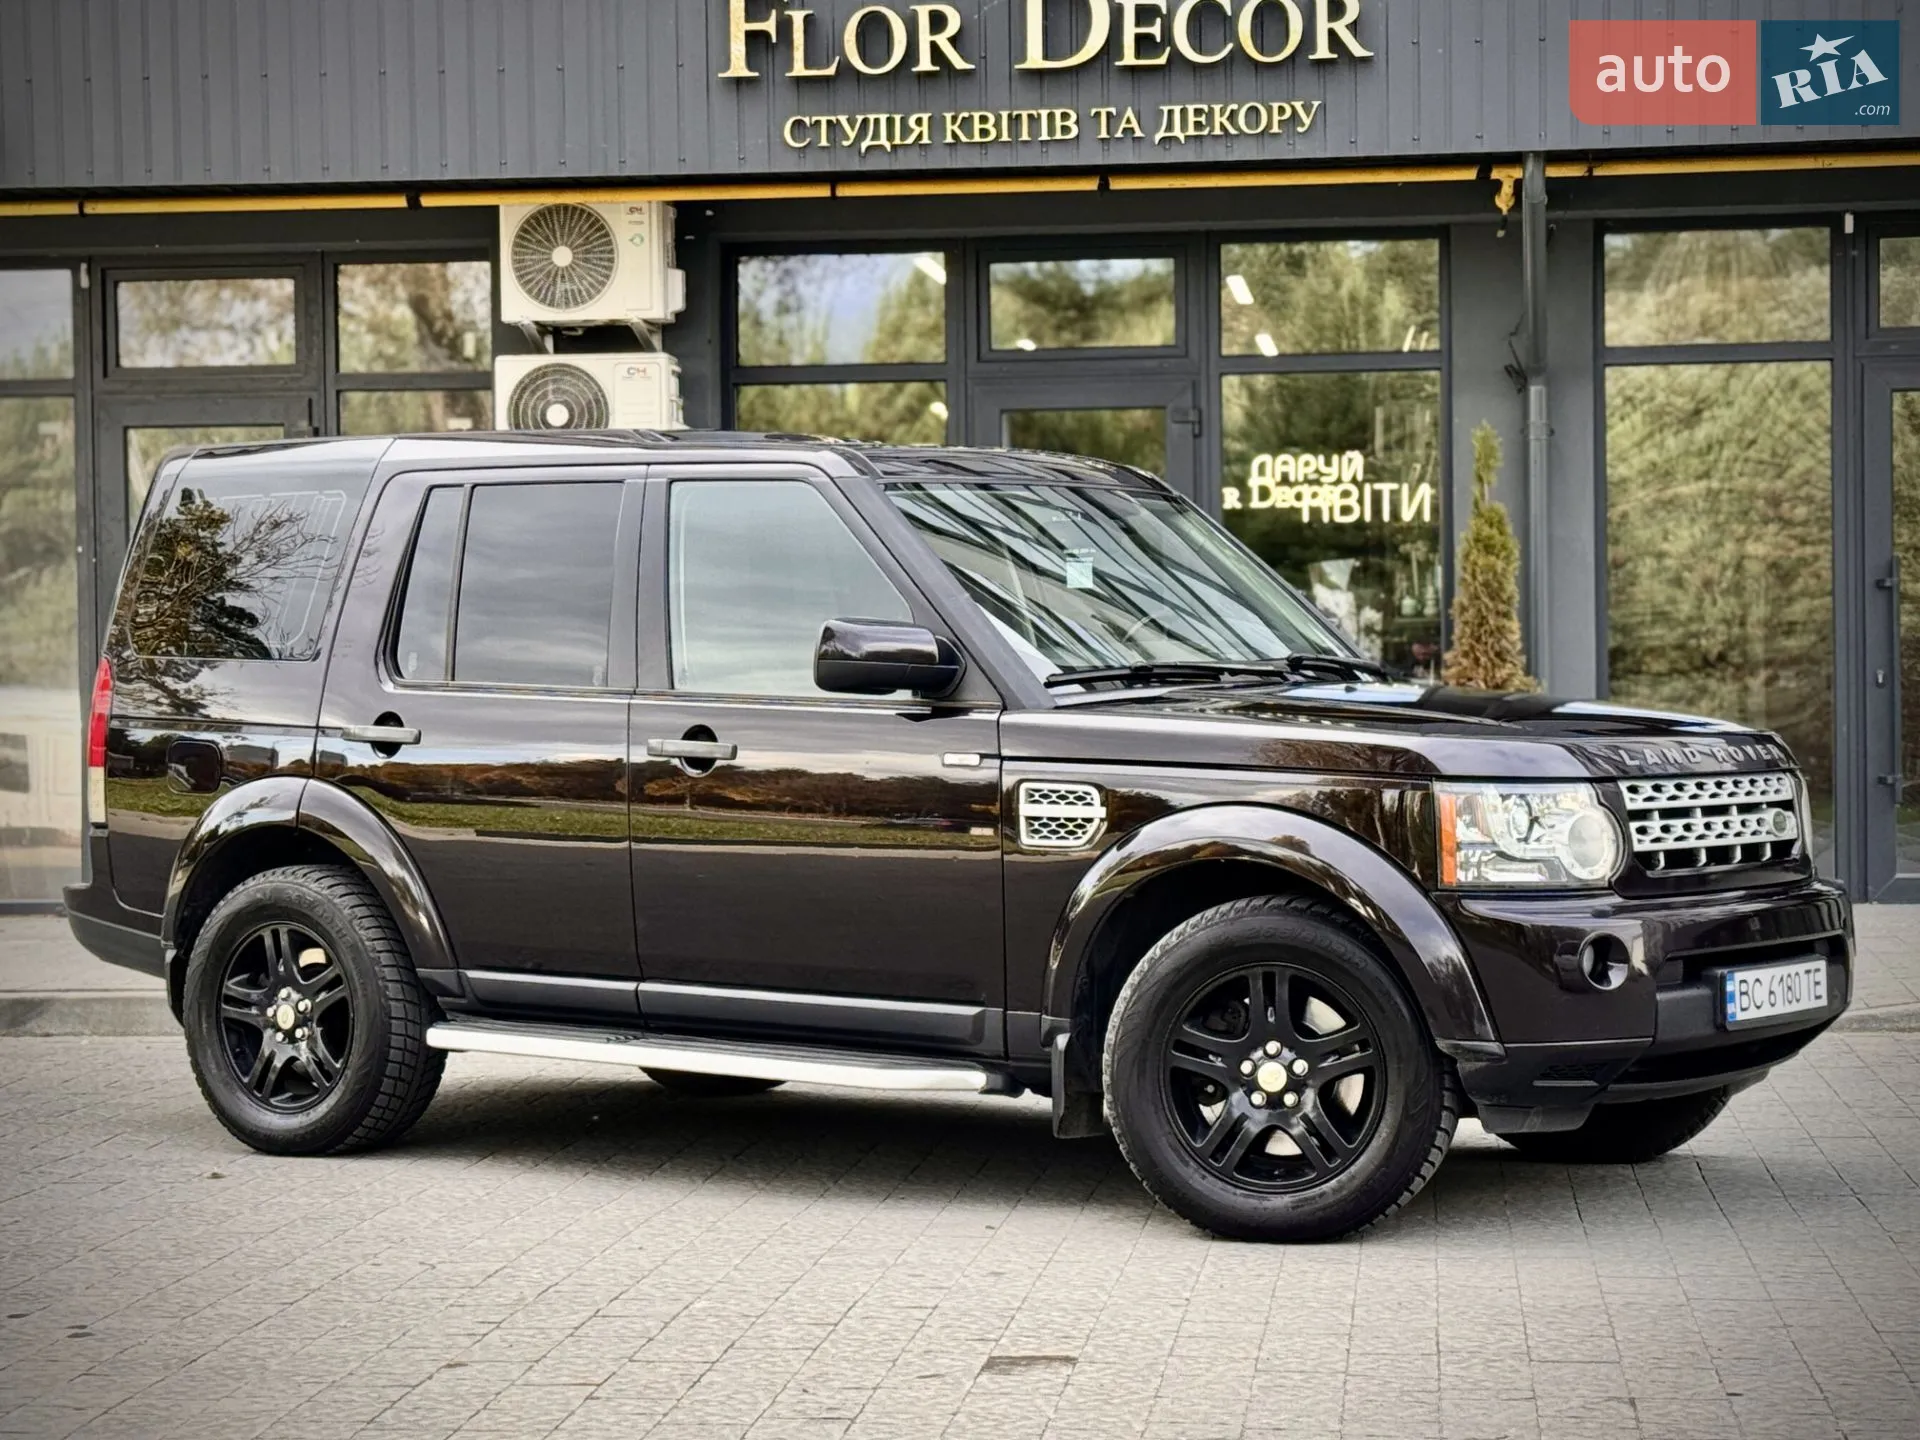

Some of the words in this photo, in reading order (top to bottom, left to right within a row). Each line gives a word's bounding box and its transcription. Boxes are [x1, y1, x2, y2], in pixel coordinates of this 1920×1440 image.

[783, 112, 933, 154] СТУДІЯ
[942, 108, 1079, 144] КВІТІВ
[1090, 106, 1145, 140] ТА
[1154, 100, 1322, 145] ДЕКОРУ
[1249, 450, 1364, 483] ДАРУЙ
[1618, 747, 1701, 766] LAND
[1711, 743, 1787, 763] ROVER
[1738, 978, 1764, 1012] BC
[1768, 971, 1802, 1008] 6180
[1804, 967, 1823, 1002] TE
